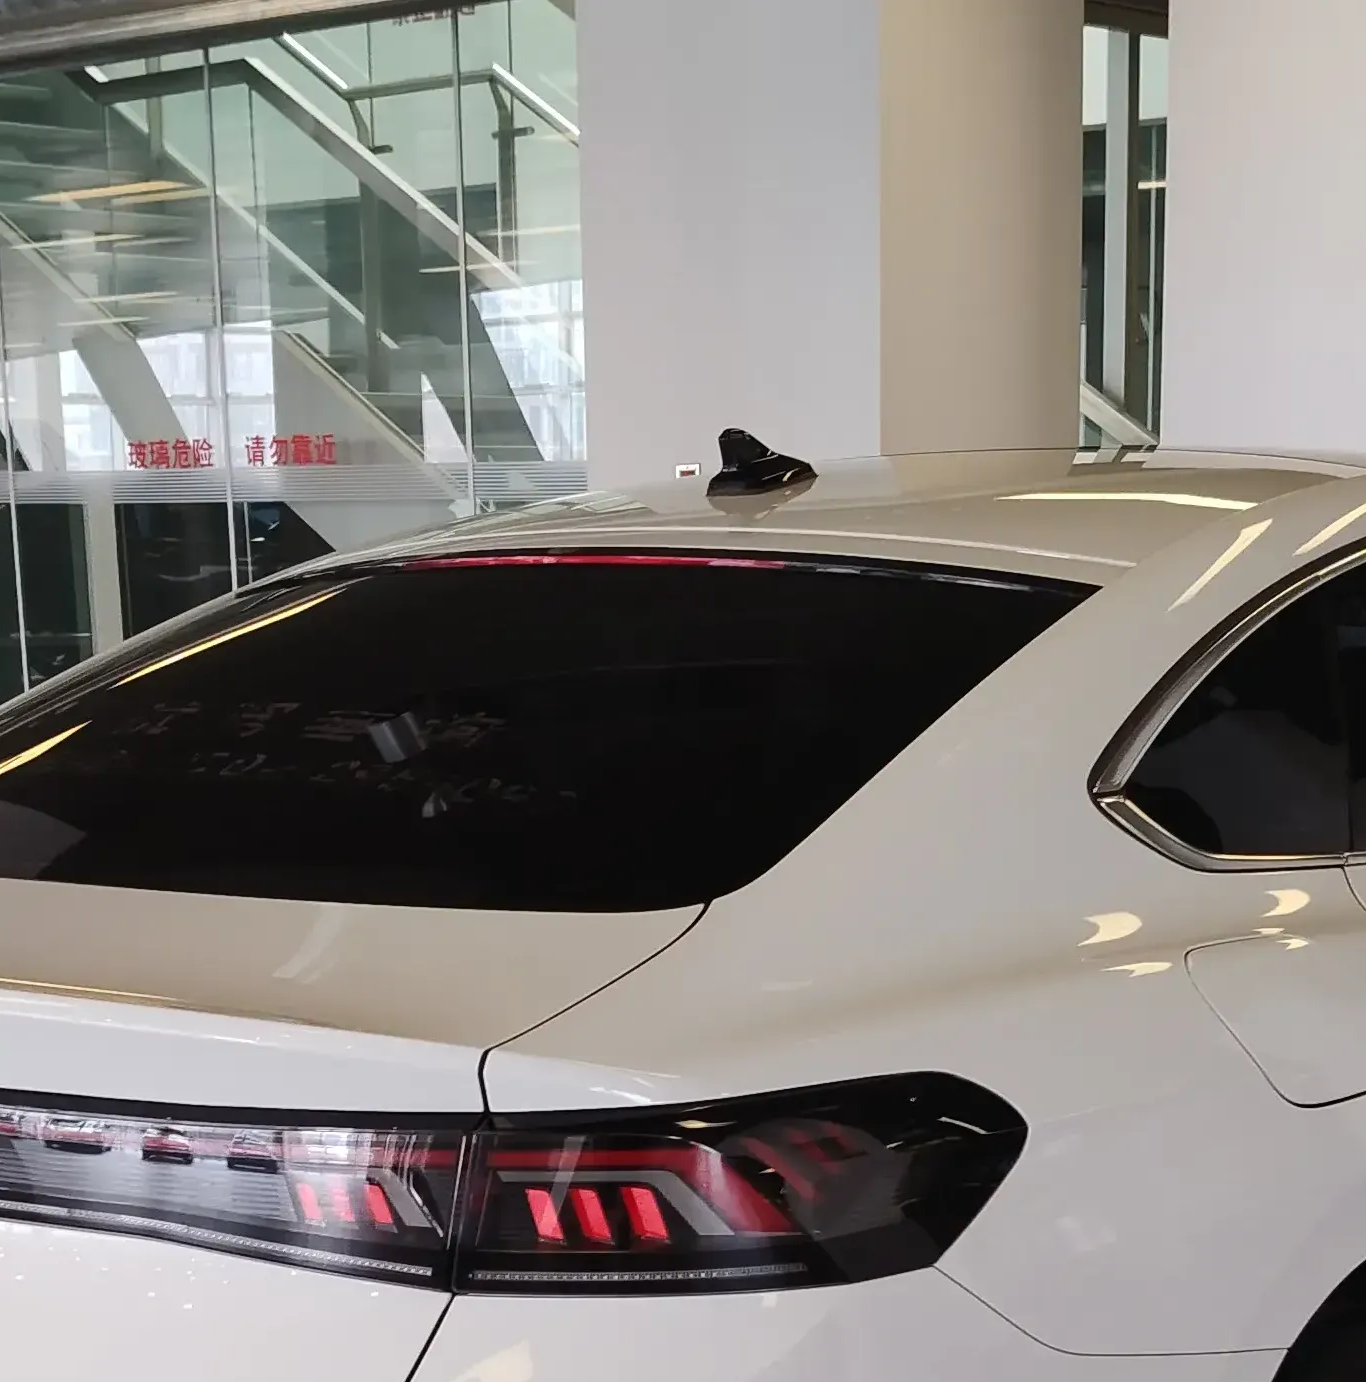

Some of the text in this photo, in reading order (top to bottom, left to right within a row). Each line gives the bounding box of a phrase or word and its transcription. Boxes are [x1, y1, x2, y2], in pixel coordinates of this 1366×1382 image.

[128, 432, 337, 469] 玻璃危险 请勿靠近
